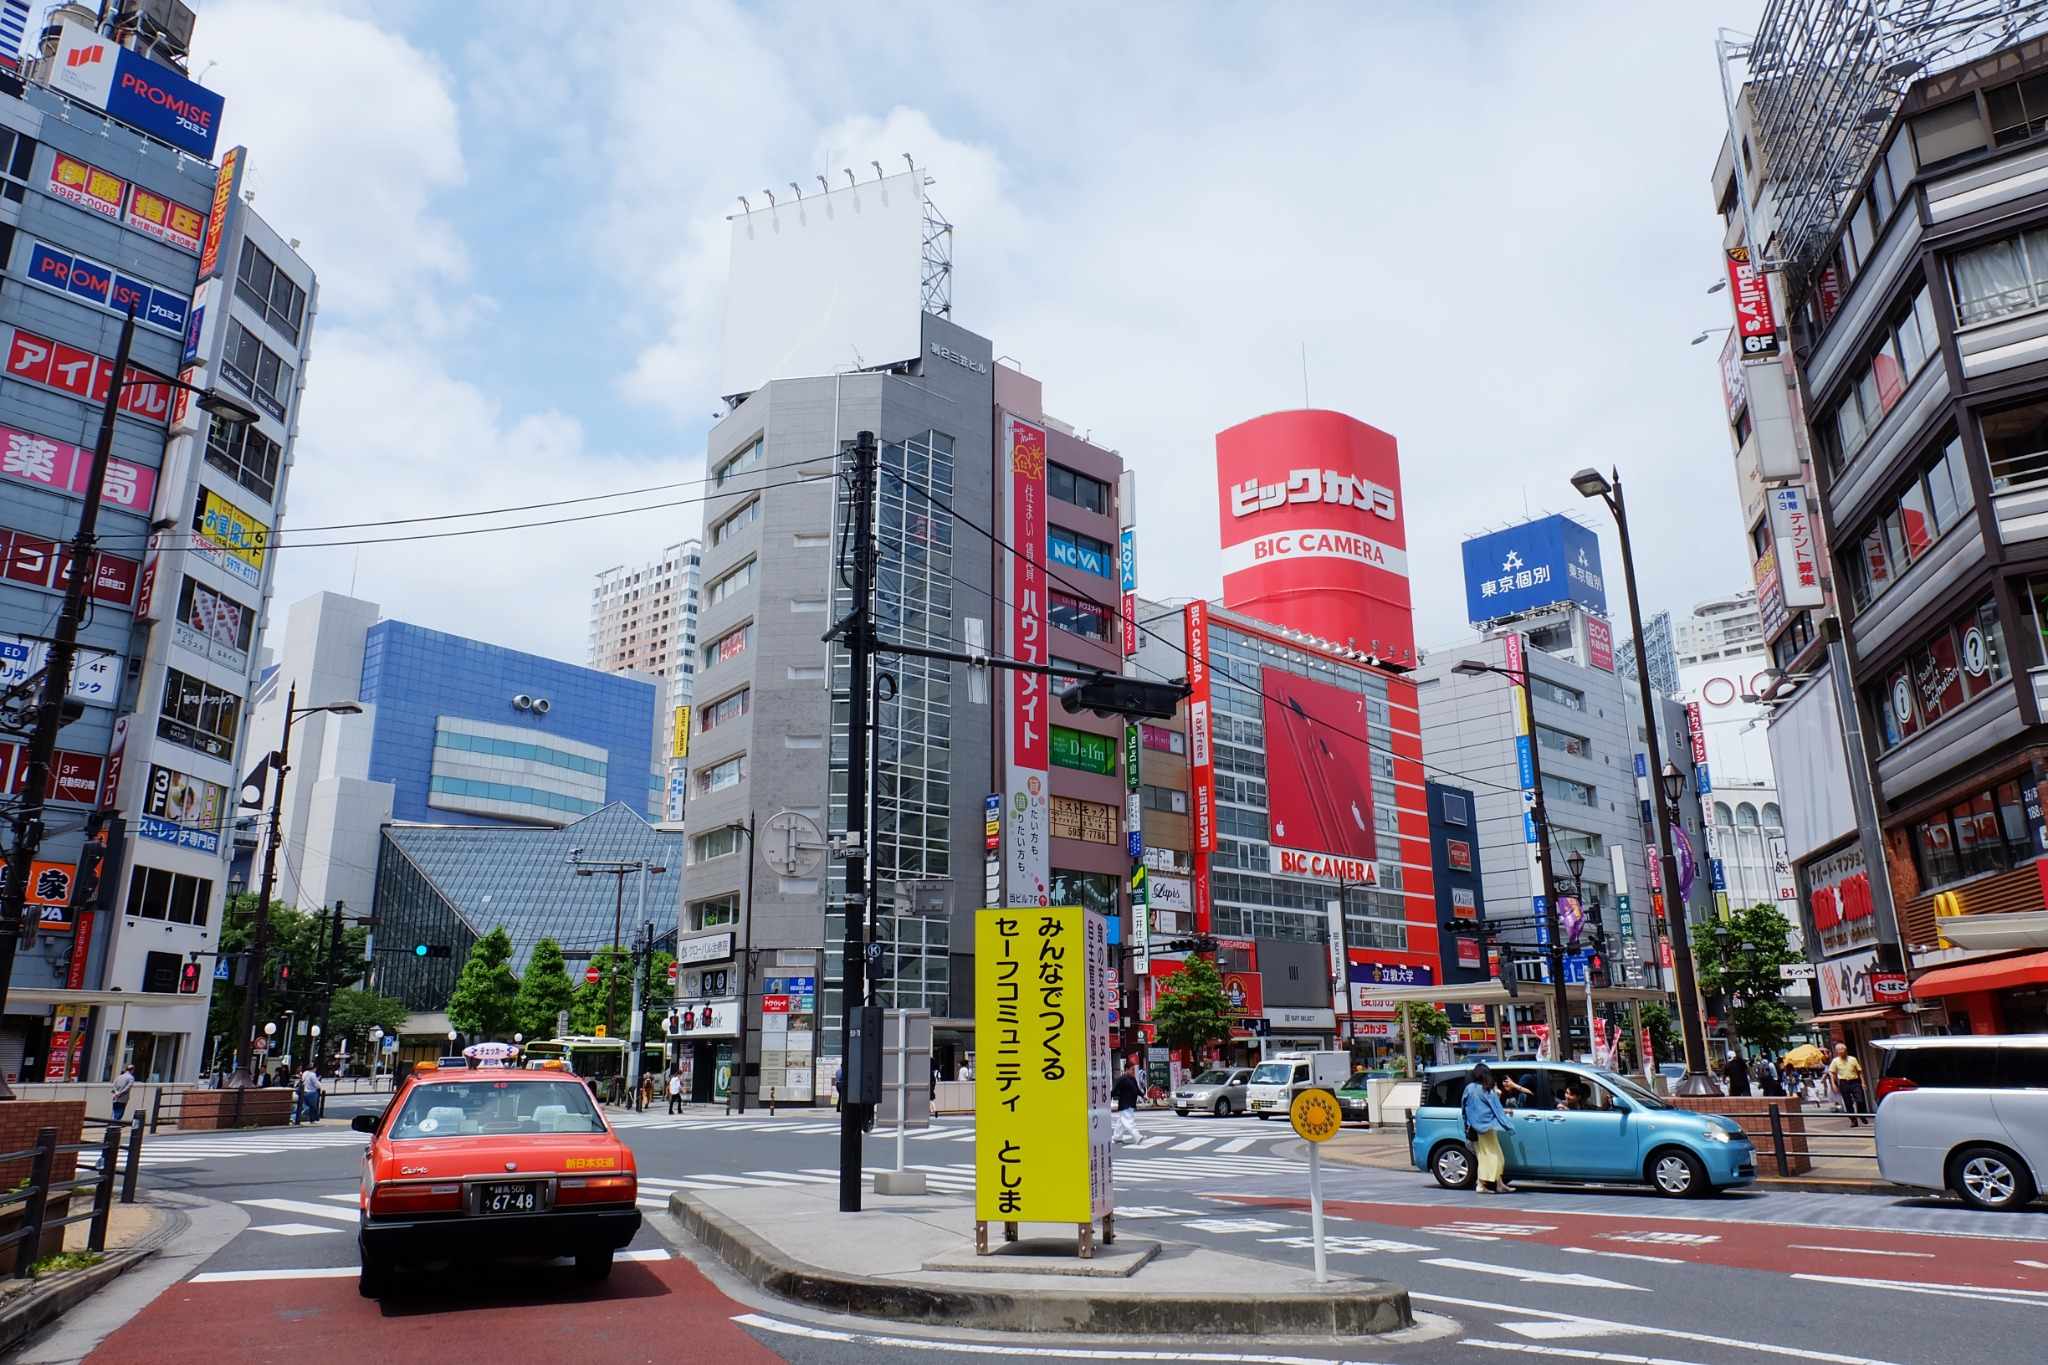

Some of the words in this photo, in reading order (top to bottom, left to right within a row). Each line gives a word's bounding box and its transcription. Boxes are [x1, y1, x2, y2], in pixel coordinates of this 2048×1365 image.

[121, 73, 212, 128] PROMISE
[175, 116, 208, 138] プロミス
[50, 183, 117, 219] 3982-0008
[42, 256, 141, 306] PROMISE
[151, 304, 183, 324] プロミス
[1736, 265, 1763, 332] Bully's
[1745, 336, 1773, 351] 6F
[1230, 468, 1396, 521] ビックカメラ
[1777, 491, 1796, 500] 4階
[1779, 501, 1798, 511] 3階
[1054, 541, 1100, 572] NOVA
[1122, 539, 1134, 583] NOVA
[1254, 536, 1291, 560] BIC
[1299, 534, 1385, 565] CAMERA
[1790, 512, 1816, 587] テナント募集
[137, 570, 154, 616] アコム
[1481, 564, 1551, 599] 東京個別
[1568, 563, 1603, 592] 東京個別
[1191, 605, 1201, 627] BIC
[1589, 622, 1609, 642] ECC
[4, 647, 21, 658] ED
[1192, 630, 1202, 684] CAMERA
[89, 663, 108, 674] 4F
[62, 765, 79, 775] 3F
[103, 757, 121, 806] アコム
[152, 770, 169, 812] 3F
[138, 819, 217, 851] ストレッチ専門店
[1281, 850, 1308, 875] BIC
[1311, 855, 1377, 882] CAMERA
[1781, 887, 1796, 898] B1
[1382, 968, 1415, 983] 立教大学
[1037, 916, 1065, 1081] みんなでつくる
[995, 917, 1022, 1112] セーフコミュニティ
[565, 1157, 616, 1170] 新日本交通
[998, 1140, 1021, 1213] としま
[492, 1193, 534, 1210] 67-48
[511, 1184, 526, 1193] 500
